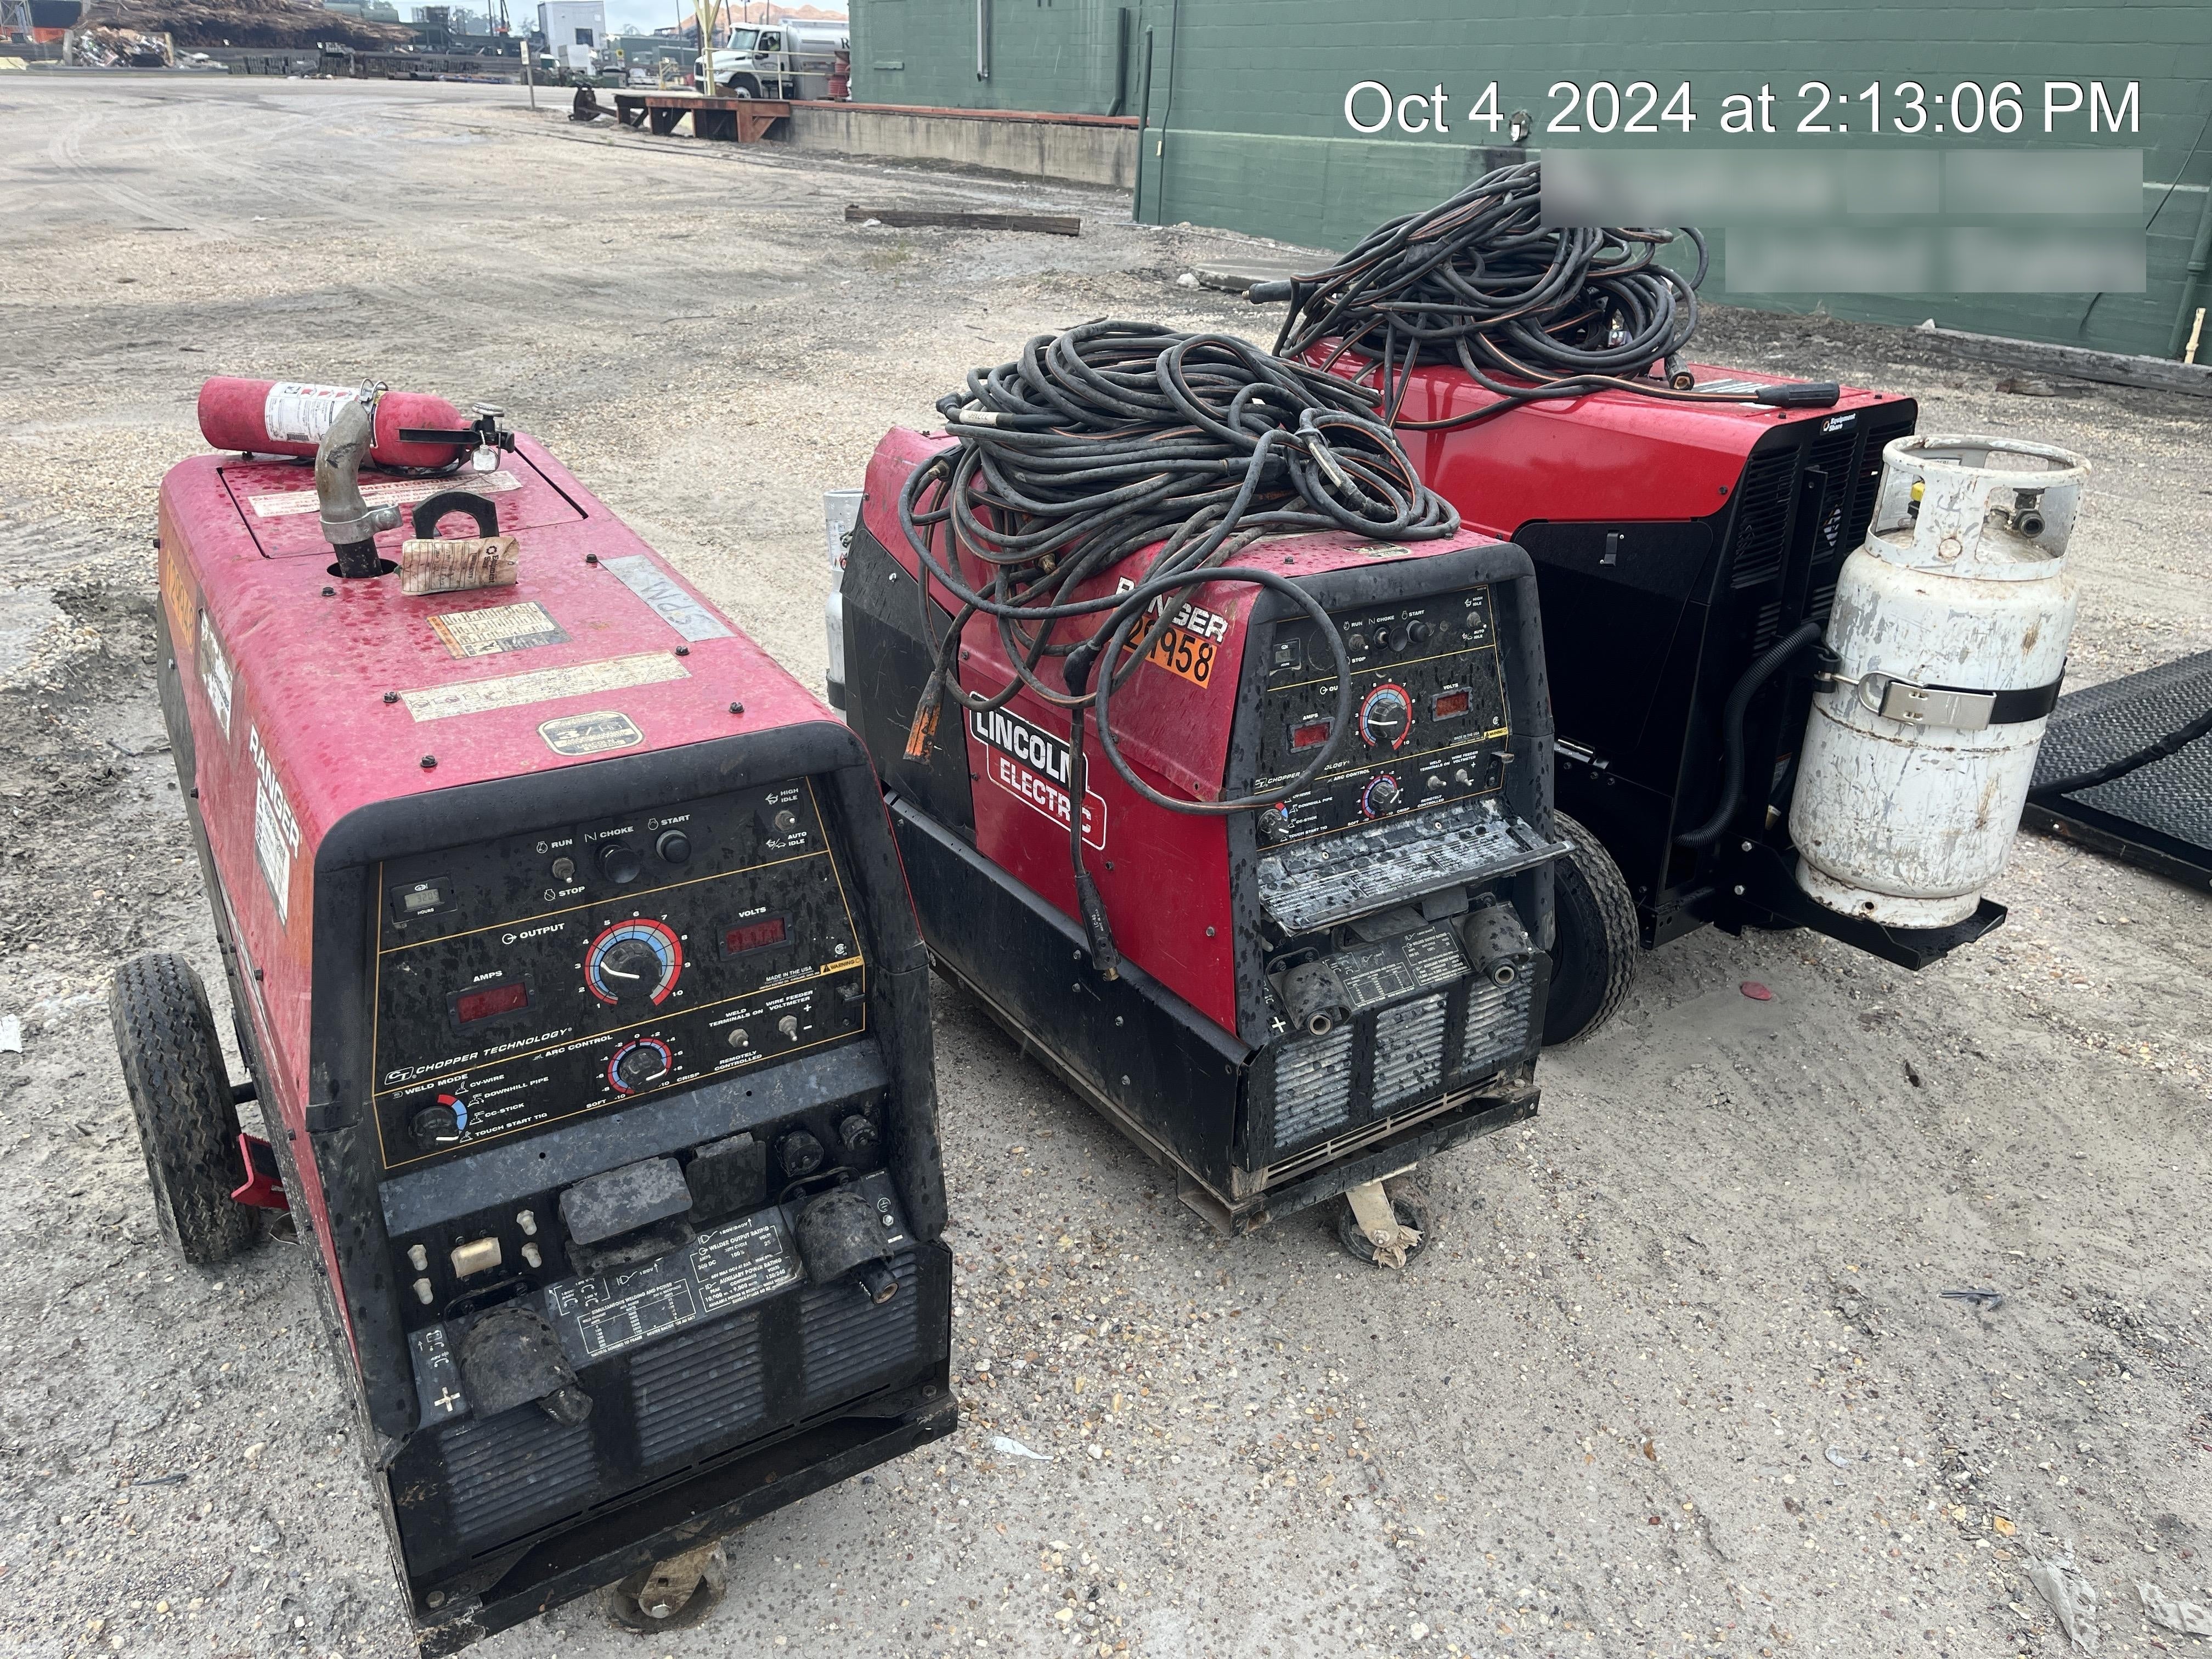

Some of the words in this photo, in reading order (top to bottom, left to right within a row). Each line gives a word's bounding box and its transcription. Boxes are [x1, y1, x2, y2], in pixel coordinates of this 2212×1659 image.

[1831, 413, 1856, 425] Equipment
[1115, 576, 1228, 643] RNGER
[1453, 755, 1476, 764] VOLTMETER
[1267, 771, 1301, 784] CHOPPER
[1346, 769, 1370, 778] CONTROL
[250, 724, 300, 860] RANGER
[780, 788, 799, 797] HIGH
[999, 757, 1091, 834] ELECTRC
[661, 815, 690, 826] START
[600, 826, 634, 838] CHOKE
[788, 832, 807, 840] AUTO
[551, 839, 573, 849] RUN
[788, 838, 805, 847] IDLE
[558, 886, 585, 897] STOP
[738, 906, 766, 918] VOLTS
[520, 923, 565, 939] OUTPUT
[830, 960, 855, 969] WARNING
[473, 970, 503, 983] AMPS
[766, 998, 784, 1006] WIRE
[786, 990, 813, 1001] FEEDER
[769, 996, 810, 1011] VOLTMETER
[709, 1012, 751, 1027] TERMINALS
[725, 1008, 747, 1018] WELD
[545, 1047, 566, 1058] ARC
[567, 1035, 613, 1052] CONTROL
[415, 1052, 478, 1075] CHOPPER
[714, 1054, 763, 1071] CONTROLLED
[719, 1050, 757, 1065] REMOTELY
[469, 1074, 505, 1088] CV-WIRE
[676, 1072, 700, 1082] CRISP
[405, 1082, 435, 1095] WELD
[437, 1073, 469, 1087] MODE
[484, 1081, 528, 1099] DOWNHILL
[530, 1076, 549, 1088] PIPE
[484, 1102, 525, 1118] CC-STICK
[586, 1098, 607, 1109] SOFT
[475, 1124, 505, 1137] TOUCH
[506, 1116, 532, 1128] START
[534, 1113, 548, 1122] TIG
[709, 1240, 730, 1250] WELDER
[730, 1232, 750, 1243] OUTPUT
[750, 1226, 769, 1236] RATING
[639, 1267, 654, 1276] 120V
[719, 1272, 744, 1284] AUXILIARY
[745, 1265, 763, 1275] POWER
[764, 1258, 782, 1268] RATING
[765, 1269, 786, 1280] 120/240
[730, 1273, 757, 1286] CONTINUOUS
[591, 1299, 625, 1315] SIMULTANEOUS
[625, 1291, 646, 1302] WELDING
[657, 1282, 673, 1291] POWER
